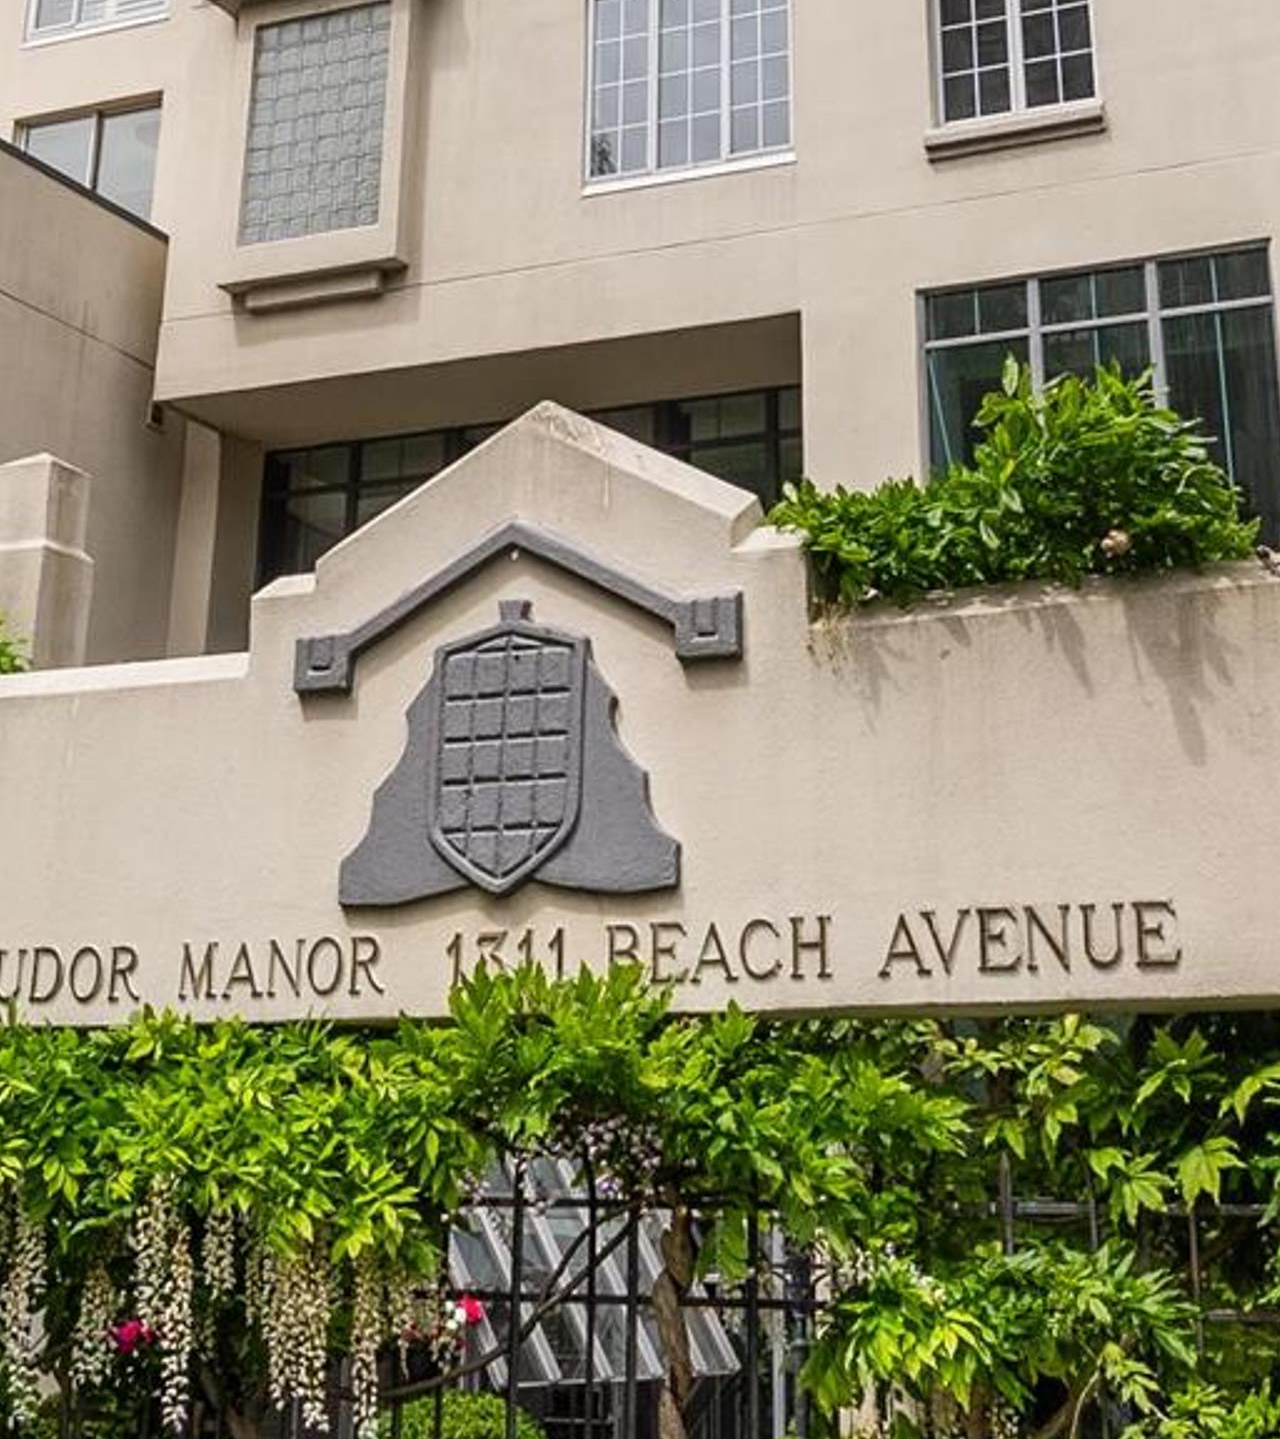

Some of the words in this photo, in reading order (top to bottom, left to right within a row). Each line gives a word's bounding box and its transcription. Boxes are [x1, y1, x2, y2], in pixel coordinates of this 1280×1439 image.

[178, 935, 385, 1002] MANOR
[606, 915, 833, 986] BEACH
[877, 900, 1182, 977] AVENUE
